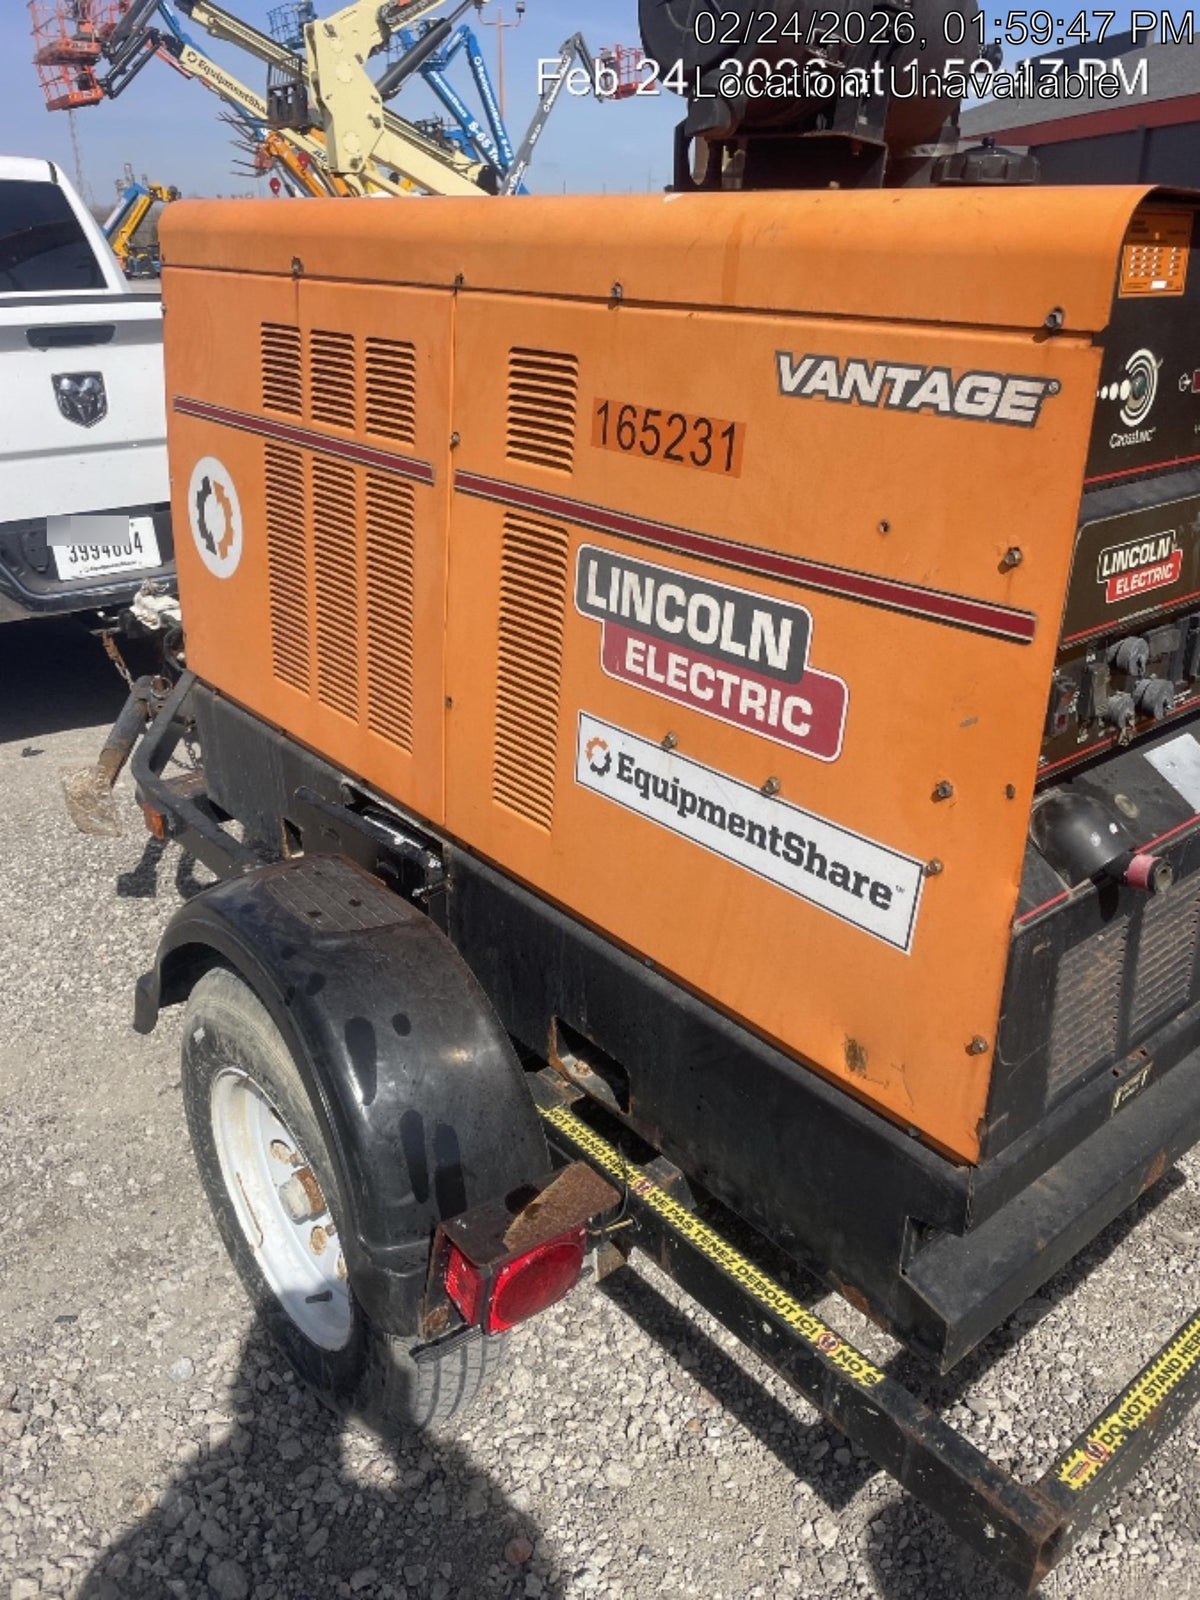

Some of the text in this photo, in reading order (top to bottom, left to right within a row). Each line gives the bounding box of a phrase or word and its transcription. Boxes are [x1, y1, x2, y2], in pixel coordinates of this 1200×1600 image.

[596, 399, 737, 473] 165231
[1101, 536, 1172, 577] LINCOLN
[1115, 562, 1174, 595] ELECTRIC
[584, 558, 793, 672] LINCOLN
[624, 636, 814, 737] ELECTRIC
[650, 1191, 669, 1213] NE
[668, 1204, 694, 1232] PAS
[695, 1226, 738, 1267] TENEZ
[736, 1264, 798, 1317] DEBOUT
[794, 1310, 819, 1337] ICI
[836, 1349, 864, 1375] NO
[1101, 1422, 1123, 1446] DO
[1119, 1396, 1147, 1427] NOT
[1142, 1357, 1184, 1399] STAND
